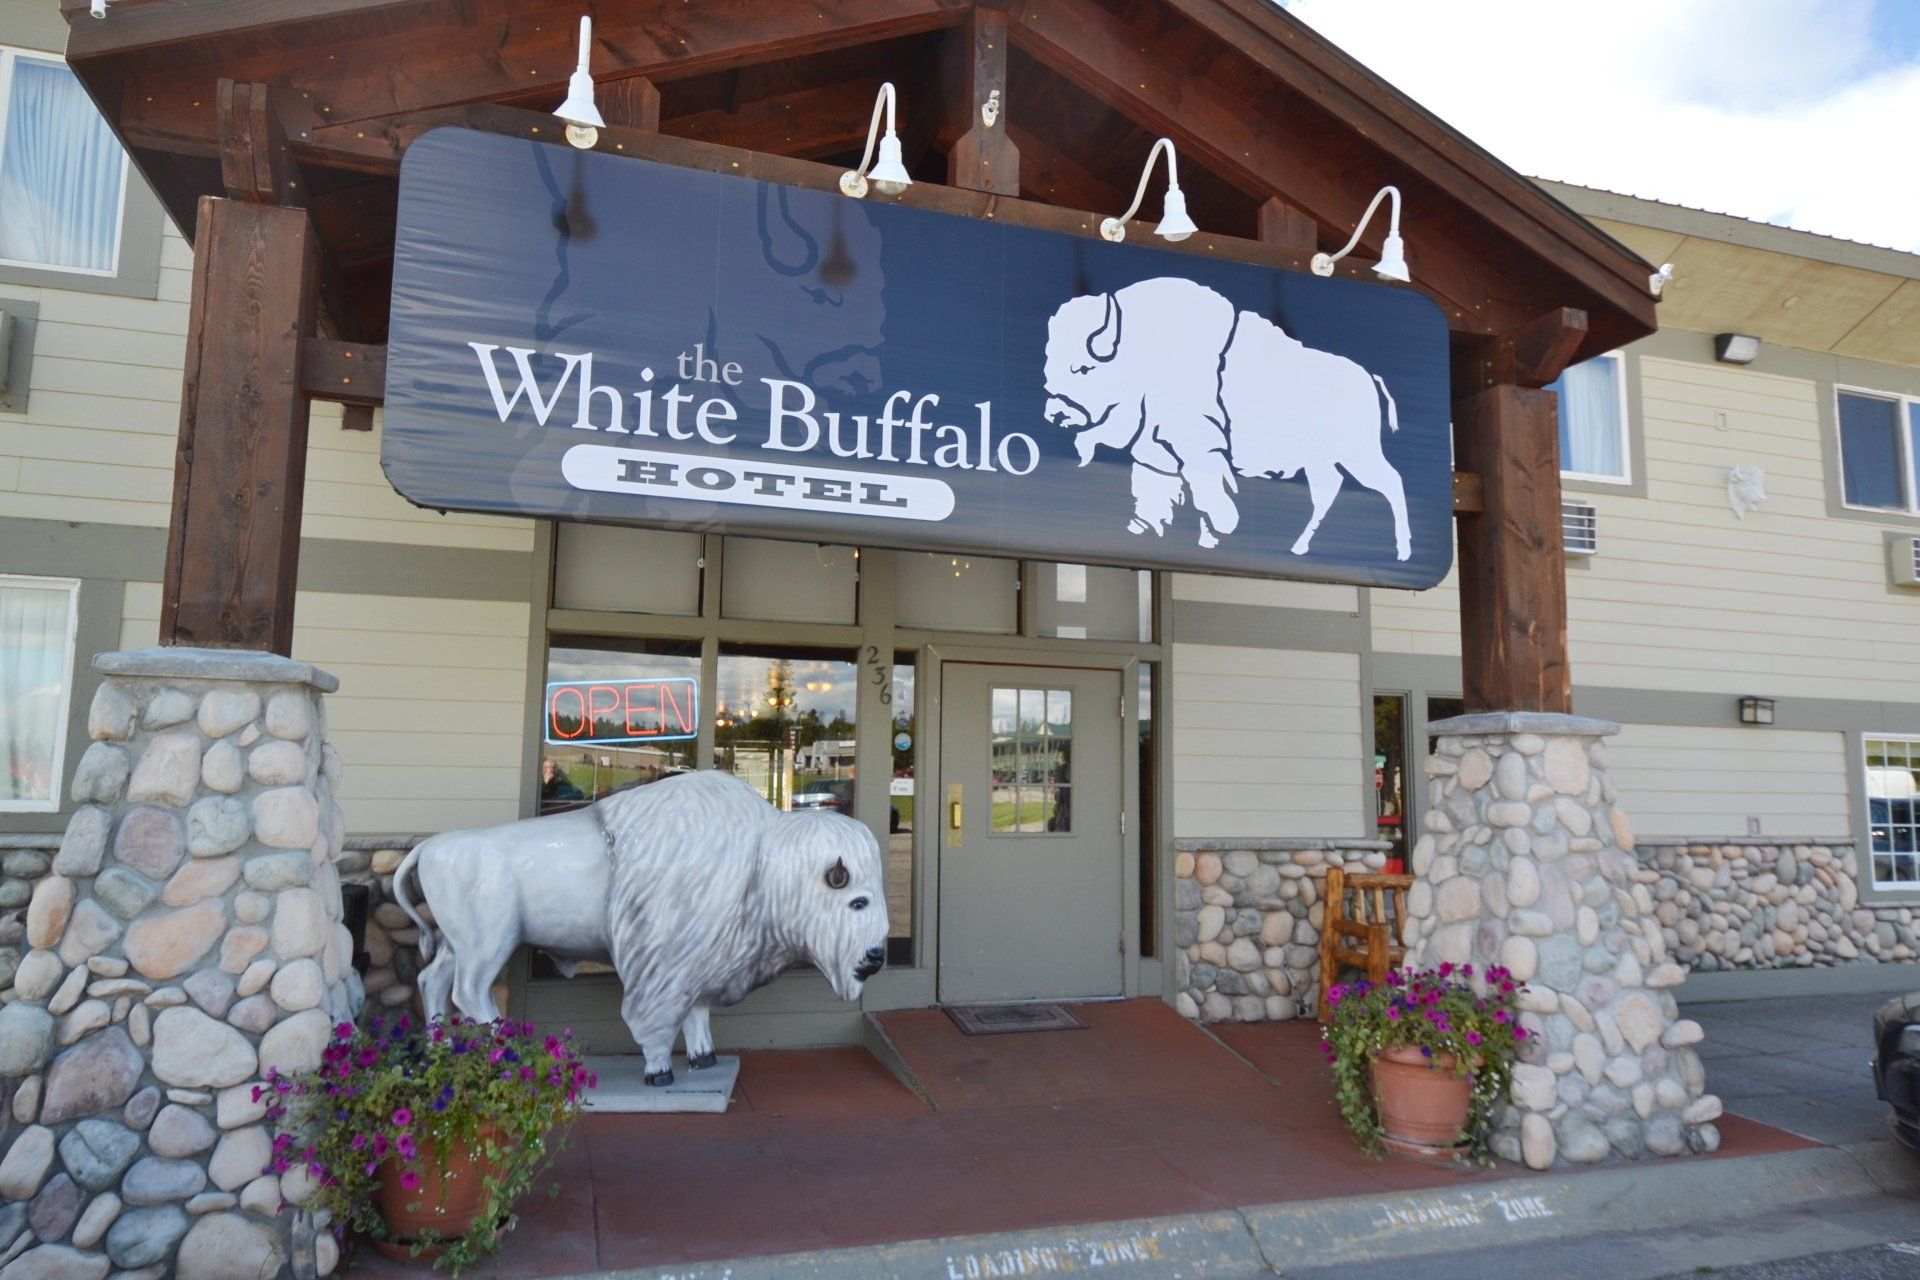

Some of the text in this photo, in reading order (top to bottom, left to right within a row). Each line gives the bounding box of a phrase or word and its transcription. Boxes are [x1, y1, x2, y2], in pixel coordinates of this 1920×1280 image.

[677, 344, 743, 386] the
[467, 341, 1041, 476] White Buffalo
[616, 457, 909, 508] HOTEL
[867, 646, 892, 705] 236
[552, 684, 692, 738] OPEN
[1498, 1194, 1553, 1222] ZONE
